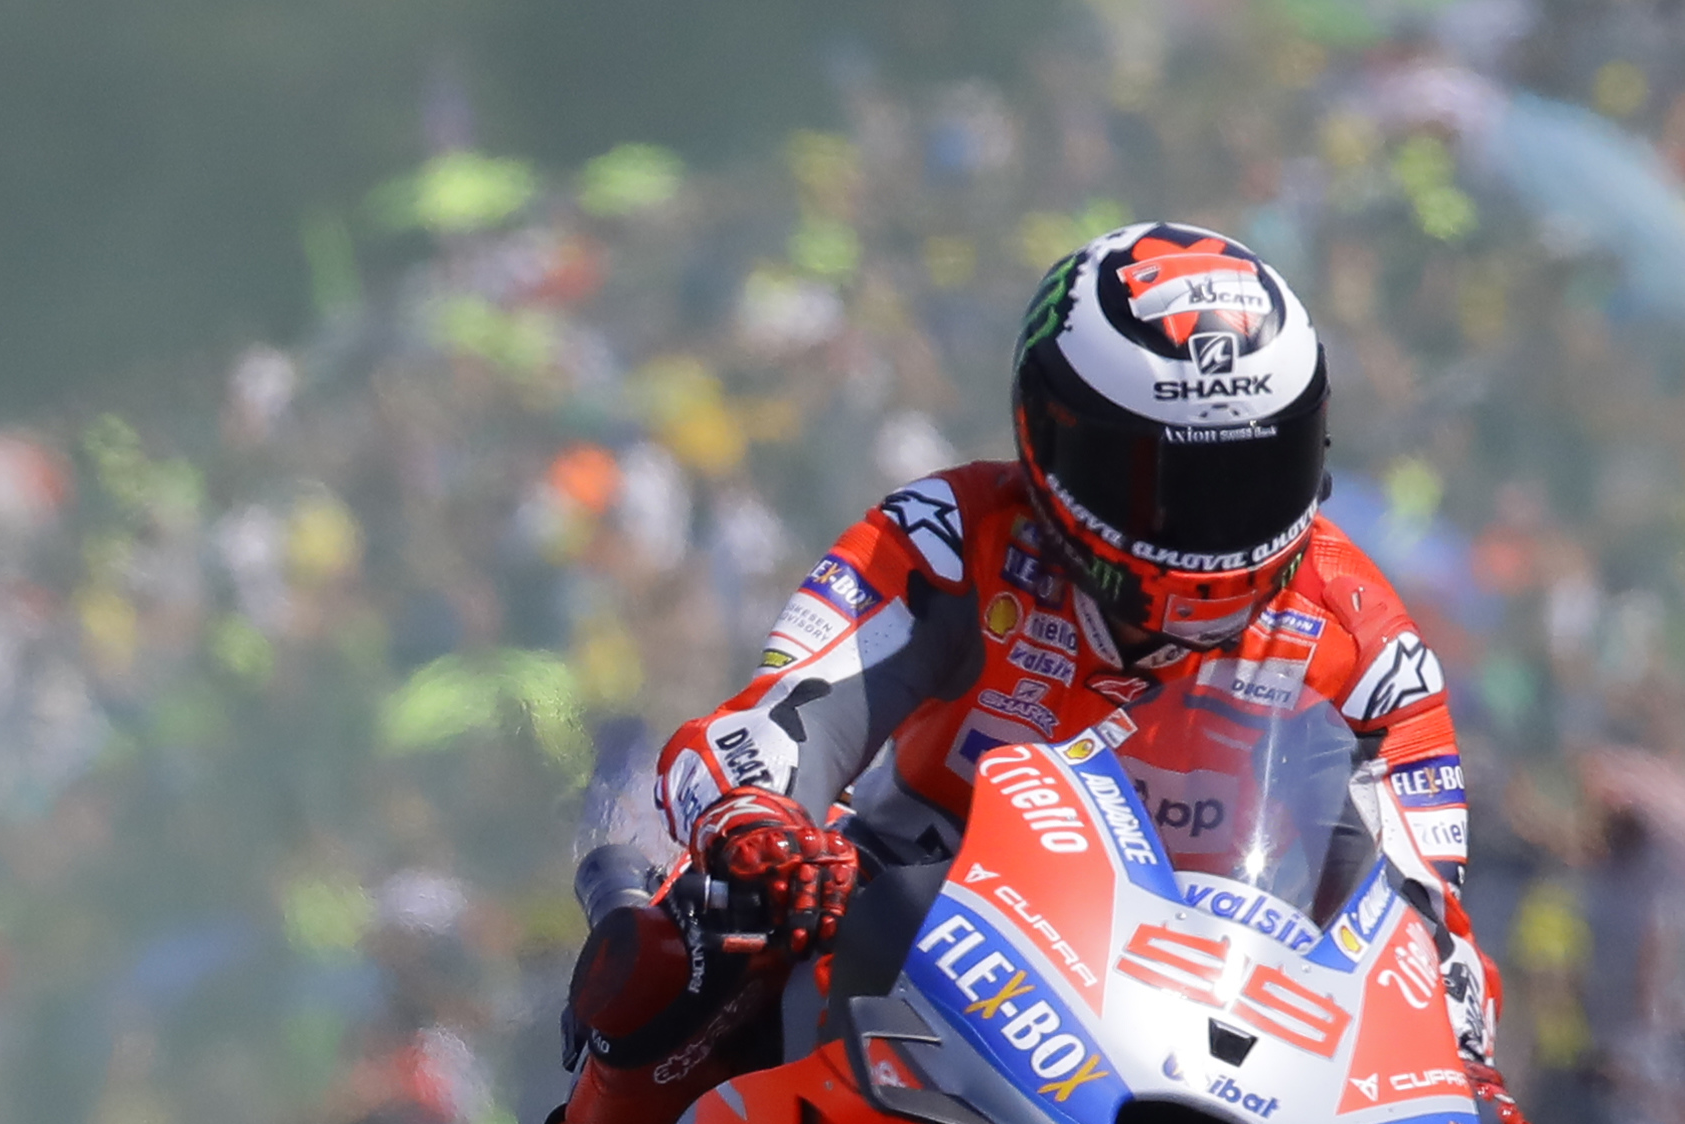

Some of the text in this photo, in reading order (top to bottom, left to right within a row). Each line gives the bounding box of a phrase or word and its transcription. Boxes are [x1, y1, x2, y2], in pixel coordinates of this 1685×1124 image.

[1153, 373, 1273, 401] SHARK
[1162, 426, 1216, 443] Axion
[810, 559, 876, 612] EX-BOX
[788, 601, 833, 633] SKESEN
[715, 727, 775, 791] DUCAT
[1390, 765, 1465, 798] FLEX-BO
[1079, 771, 1158, 867] ADVANCE
[994, 885, 1099, 988] CUPRA
[1182, 883, 1313, 950] valsir
[916, 913, 1110, 1103] FLEX-BOX
